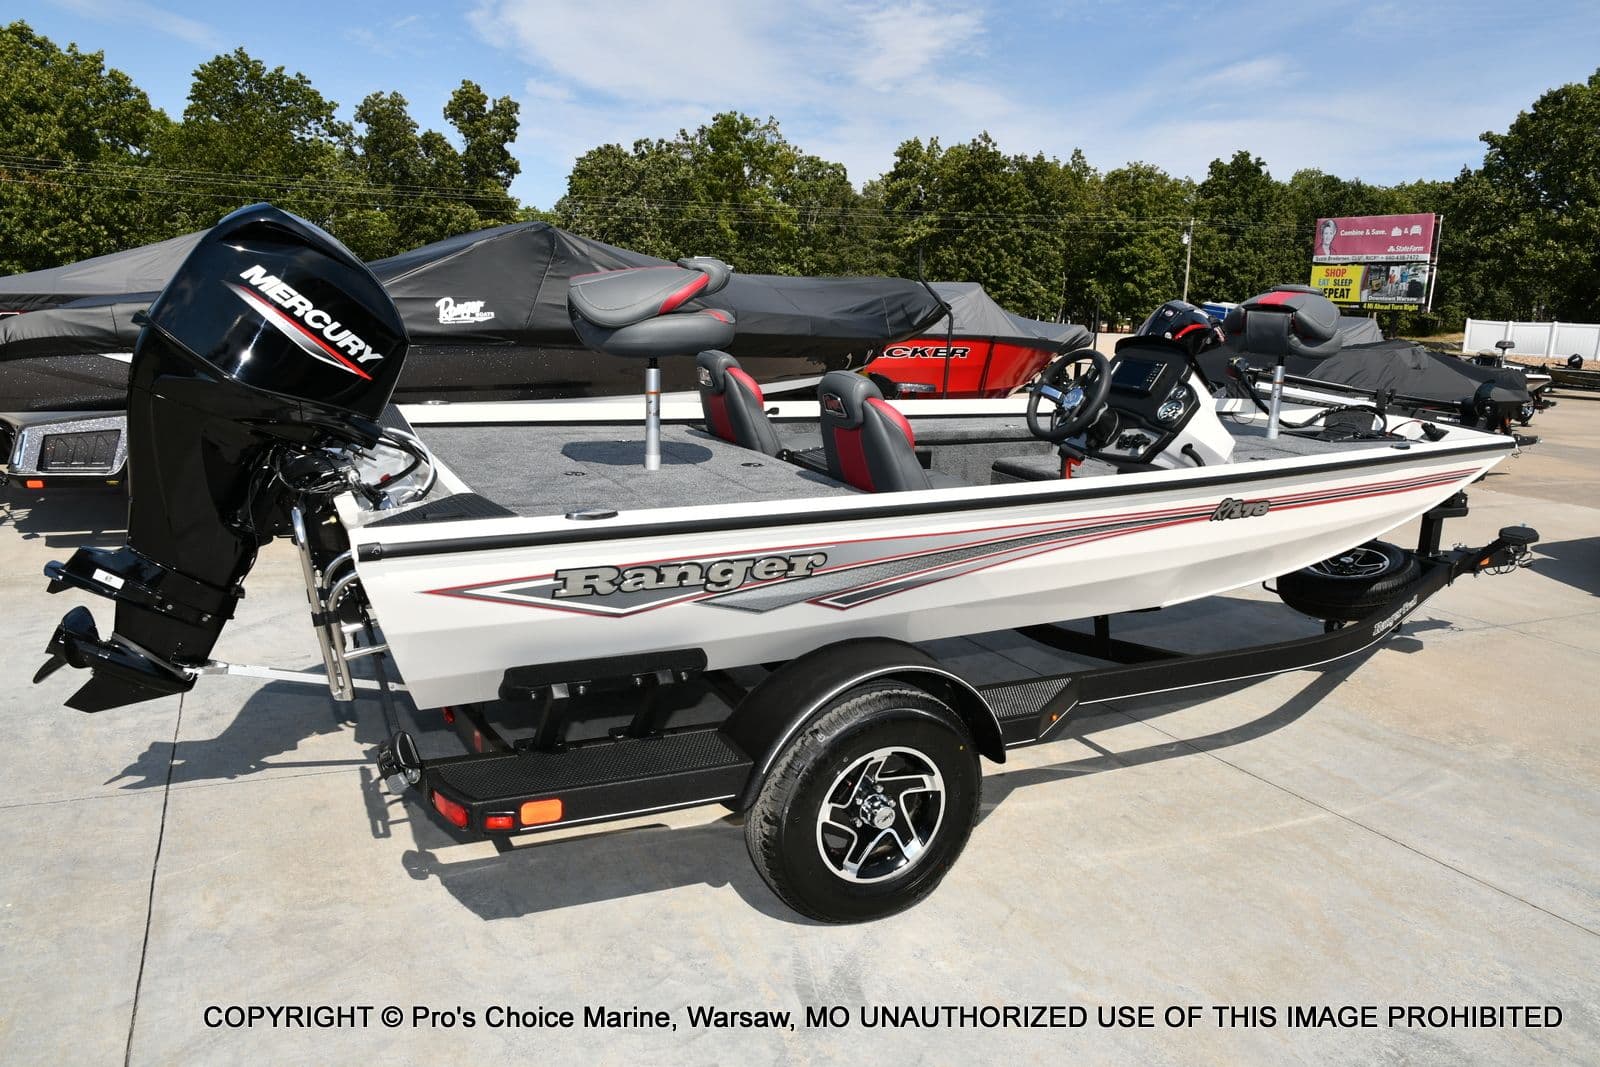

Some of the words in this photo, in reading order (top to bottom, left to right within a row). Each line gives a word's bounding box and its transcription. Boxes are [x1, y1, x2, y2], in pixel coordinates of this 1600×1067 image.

[1340, 229, 1364, 237] Combine
[1325, 268, 1347, 277] SHOP
[1321, 287, 1351, 299] EPEAT
[1404, 303, 1419, 311] Right
[239, 264, 384, 363] MERCURY
[878, 345, 970, 359] CKER
[551, 552, 828, 599] Ranger
